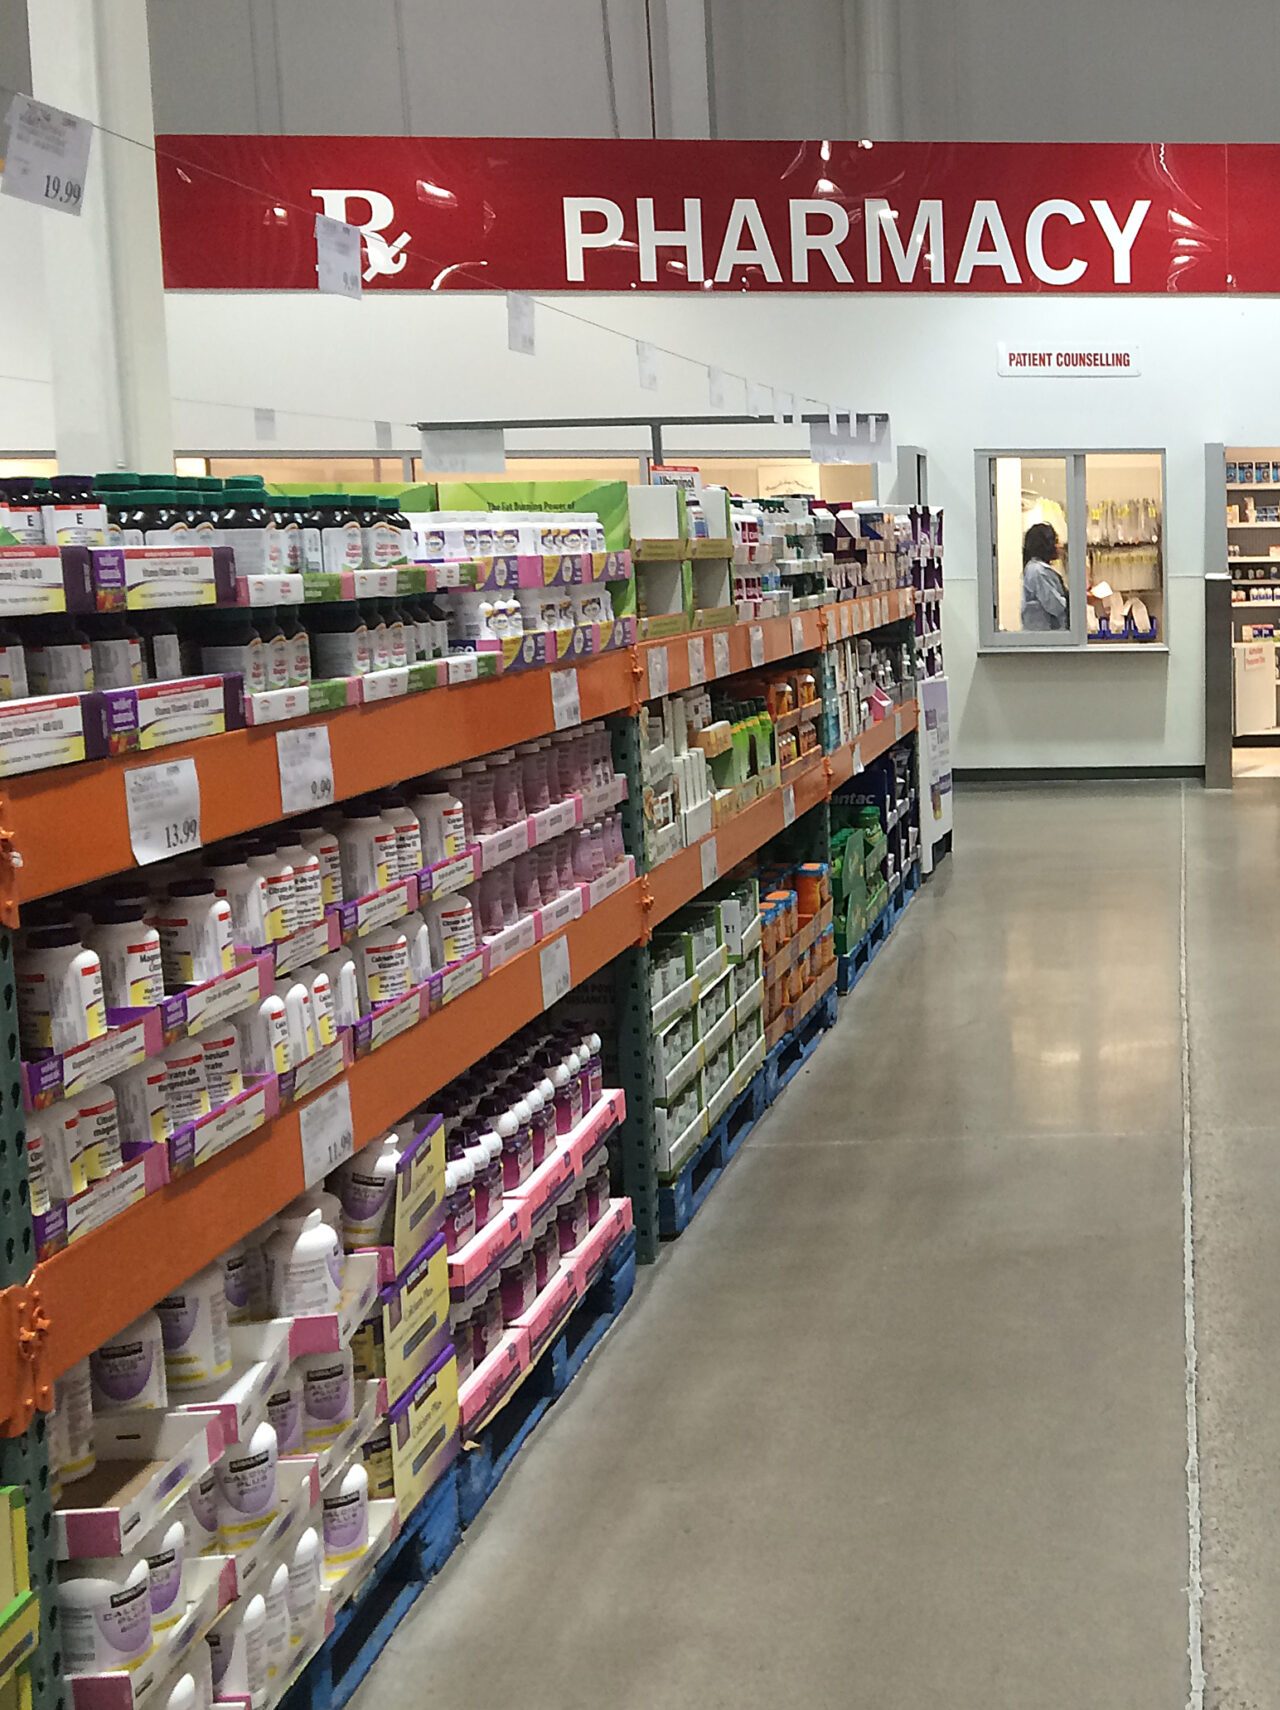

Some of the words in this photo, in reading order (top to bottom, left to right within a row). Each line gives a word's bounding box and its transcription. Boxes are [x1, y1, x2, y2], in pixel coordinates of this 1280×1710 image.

[44, 174, 82, 207] 19.99
[563, 196, 1152, 286] PHARMACY
[1009, 353, 1053, 367] PATIENT
[1056, 353, 1130, 367] COUNSELLING
[27, 514, 34, 527] E
[76, 513, 83, 525] E
[165, 818, 199, 850] 13.99
